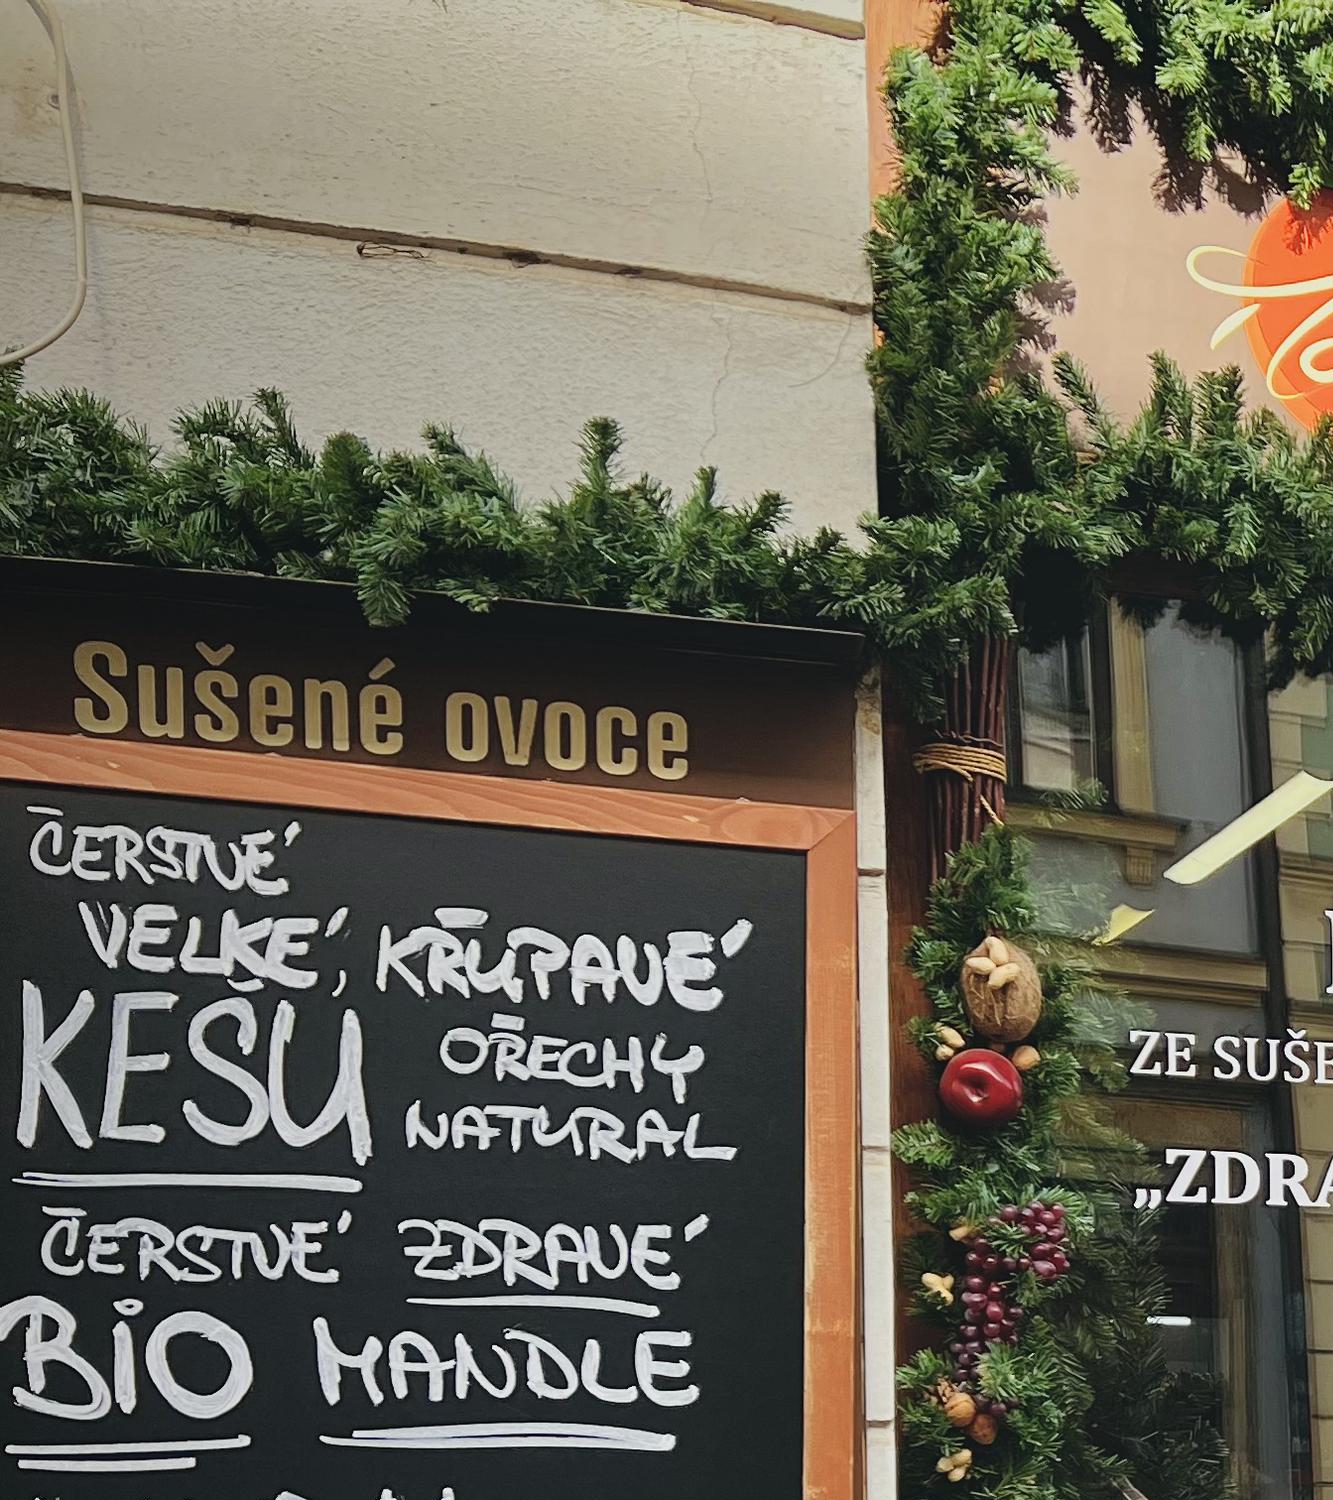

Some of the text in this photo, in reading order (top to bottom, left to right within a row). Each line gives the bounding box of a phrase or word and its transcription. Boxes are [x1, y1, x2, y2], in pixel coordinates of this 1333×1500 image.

[73, 641, 689, 780] Sušené ovoce
[27, 807, 301, 894] ČERSTVÉ
[439, 1013, 704, 1104] OŘECHY
[1128, 1030, 1197, 1079] ZE
[406, 1101, 738, 1163] NATURAL
[41, 1207, 708, 1289] ČERSTVÉ ZDRAVÉ
[314, 1317, 700, 1407] MANDLE
